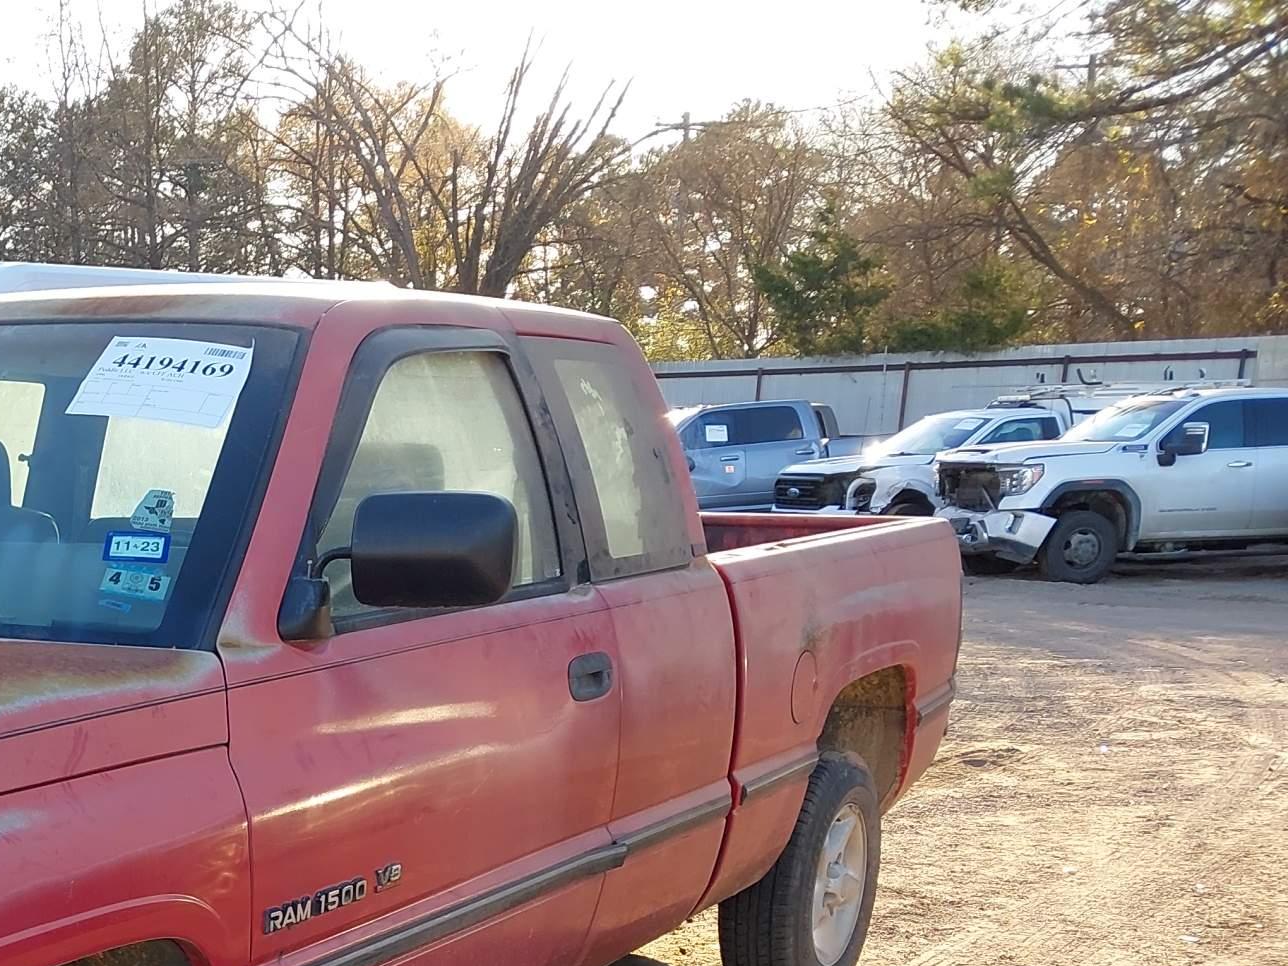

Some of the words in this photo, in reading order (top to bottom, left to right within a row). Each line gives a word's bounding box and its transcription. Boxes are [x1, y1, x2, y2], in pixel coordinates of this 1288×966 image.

[112, 353, 235, 378] 44194169
[108, 571, 122, 585] 4
[148, 576, 162, 592] 5
[267, 896, 313, 934] RAM
[316, 877, 368, 915] 1500
[376, 863, 403, 886] V8
